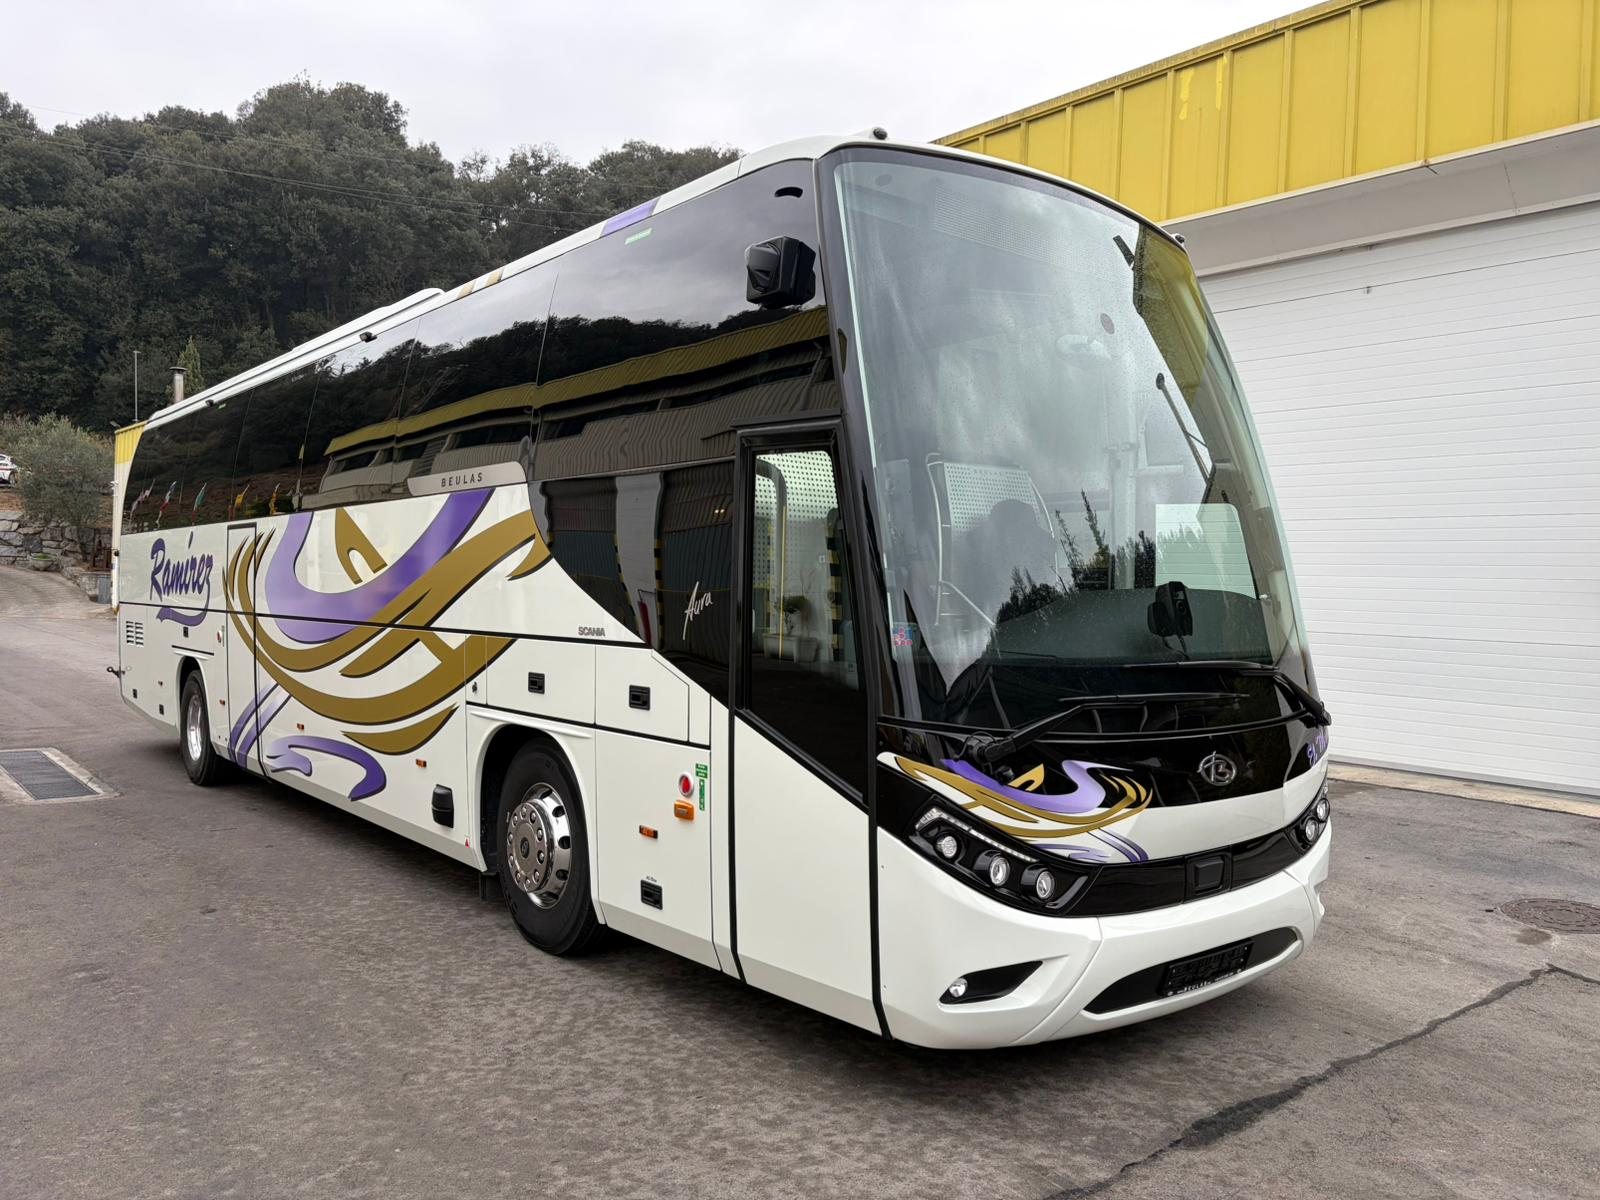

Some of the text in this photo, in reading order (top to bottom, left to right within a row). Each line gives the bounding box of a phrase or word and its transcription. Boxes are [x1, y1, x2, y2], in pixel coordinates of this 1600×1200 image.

[441, 472, 484, 488] BEULAS
[682, 580, 714, 641] Aura
[578, 626, 606, 638] SCANIA
